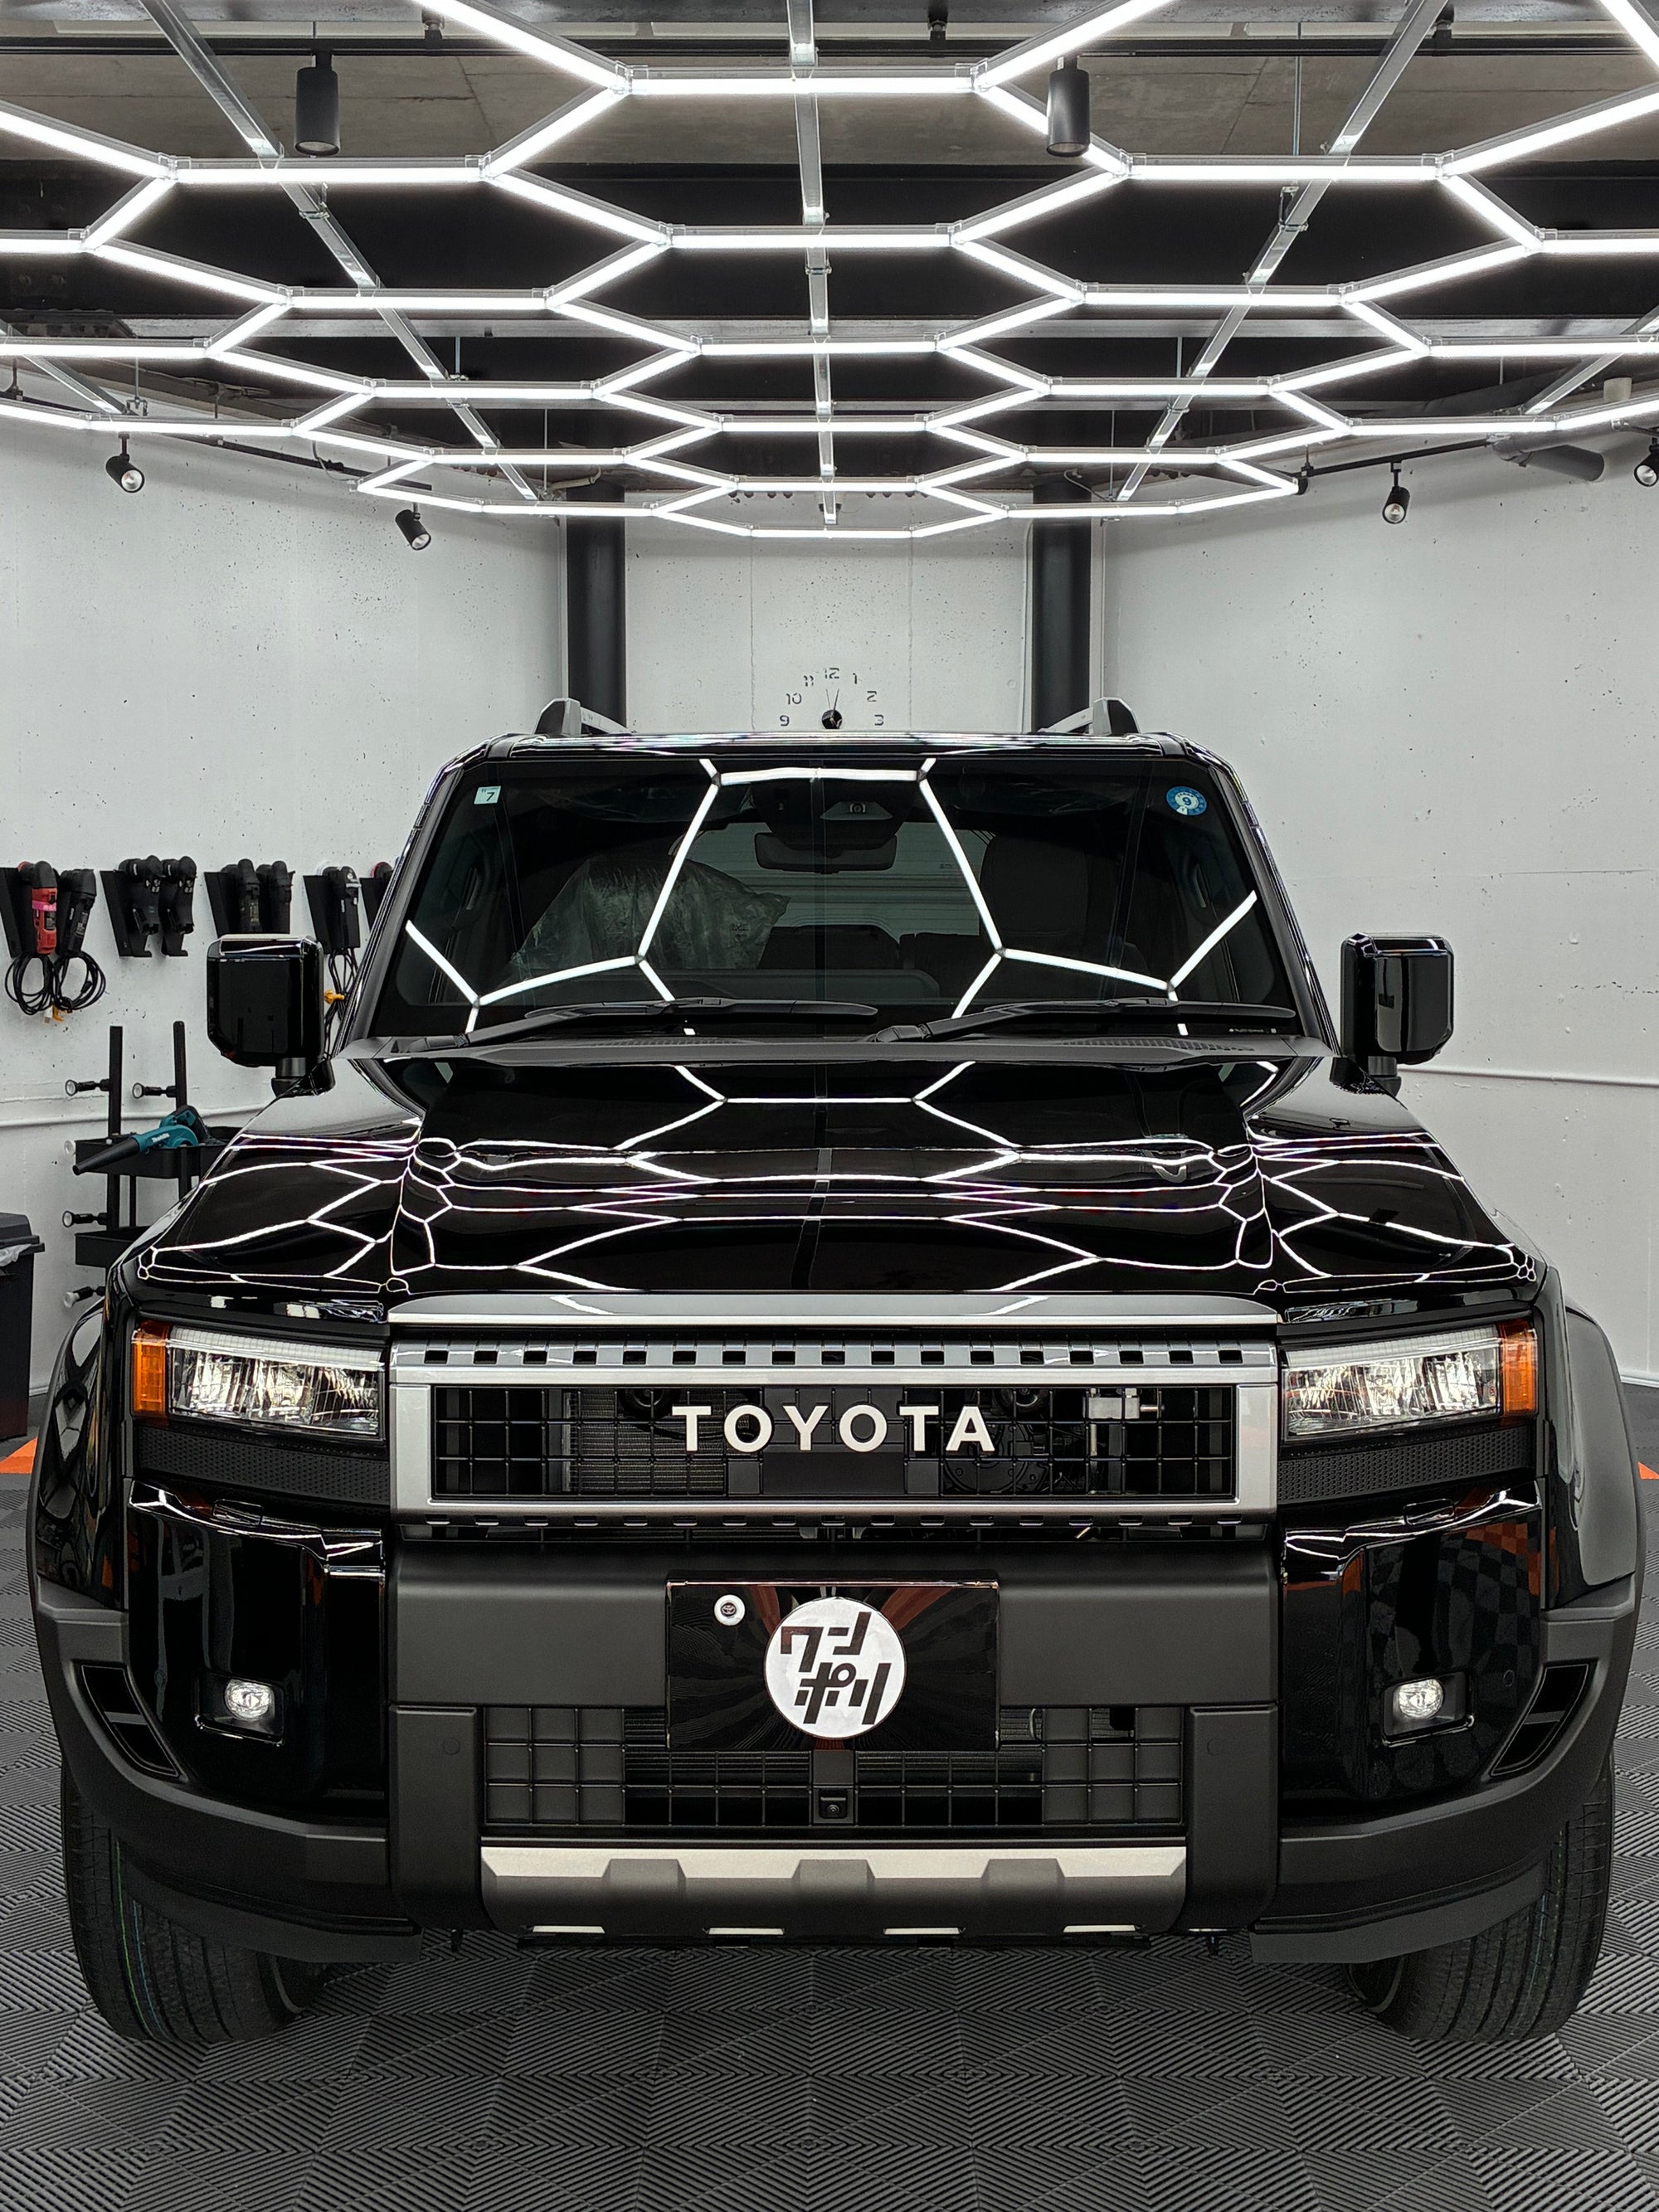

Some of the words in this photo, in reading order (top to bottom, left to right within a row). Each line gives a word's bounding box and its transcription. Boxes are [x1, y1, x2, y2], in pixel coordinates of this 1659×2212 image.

[825, 667, 840, 679] 12
[852, 673, 858, 685] 1
[786, 692, 802, 705] 10
[866, 690, 878, 702] 2
[779, 714, 790, 727] 9
[873, 714, 884, 727] 3
[486, 791, 495, 802] 7
[1182, 796, 1192, 806] 9
[672, 1404, 995, 1452] TOYOTA
